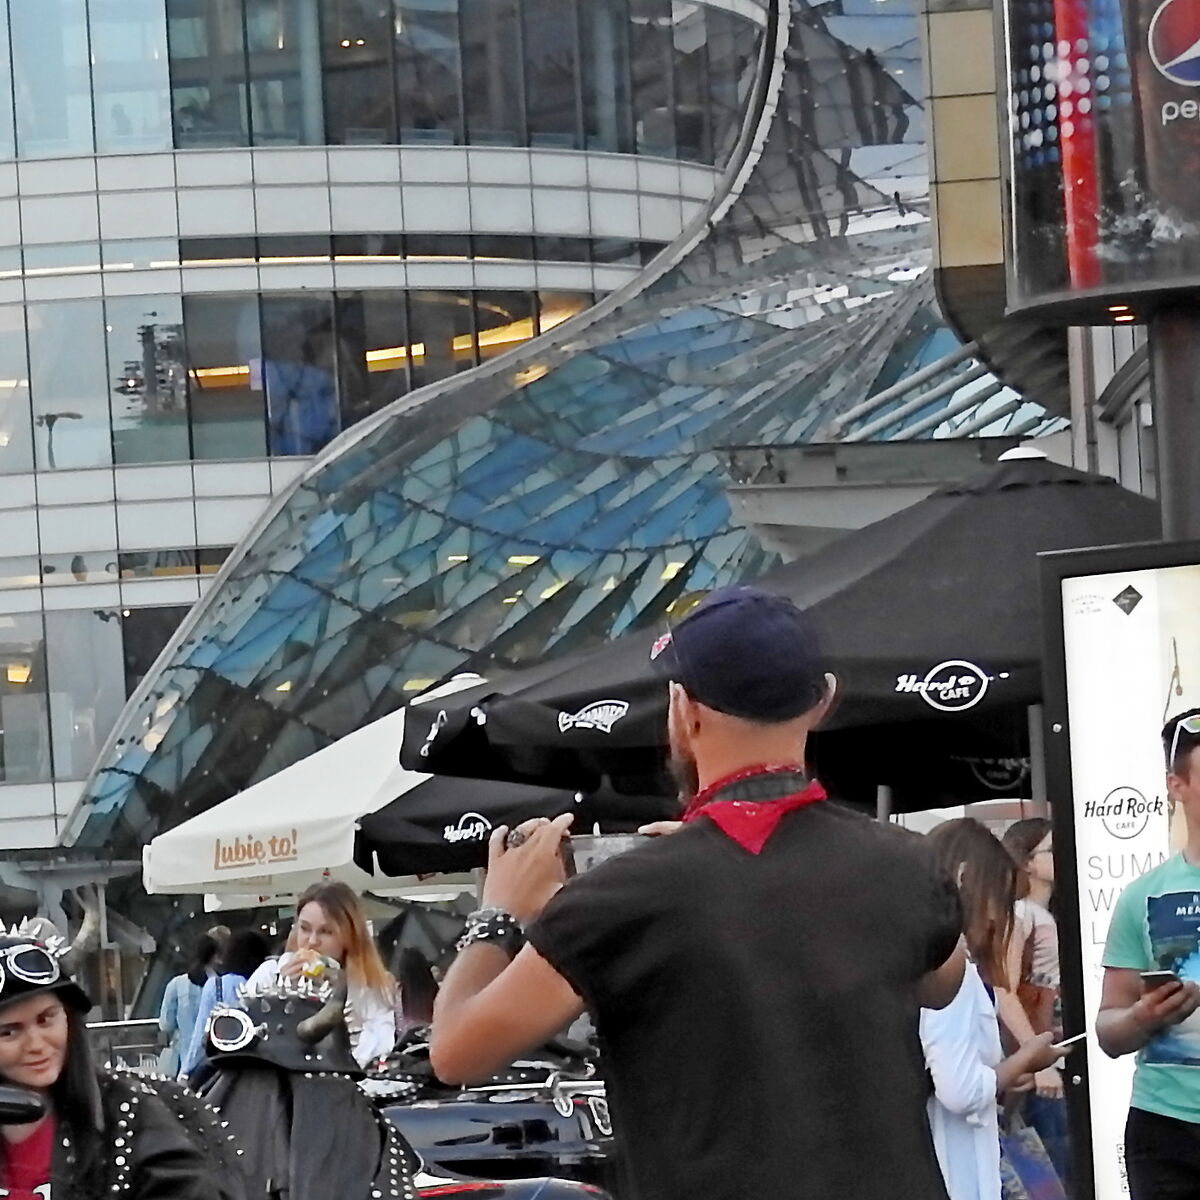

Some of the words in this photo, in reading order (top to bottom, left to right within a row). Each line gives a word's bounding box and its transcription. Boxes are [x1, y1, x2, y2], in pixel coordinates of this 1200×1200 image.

[1162, 100, 1200, 126] pe
[940, 687, 970, 700] CAFE
[1085, 800, 1123, 817] Hard
[1126, 796, 1163, 817] Rock
[268, 828, 298, 857] to!
